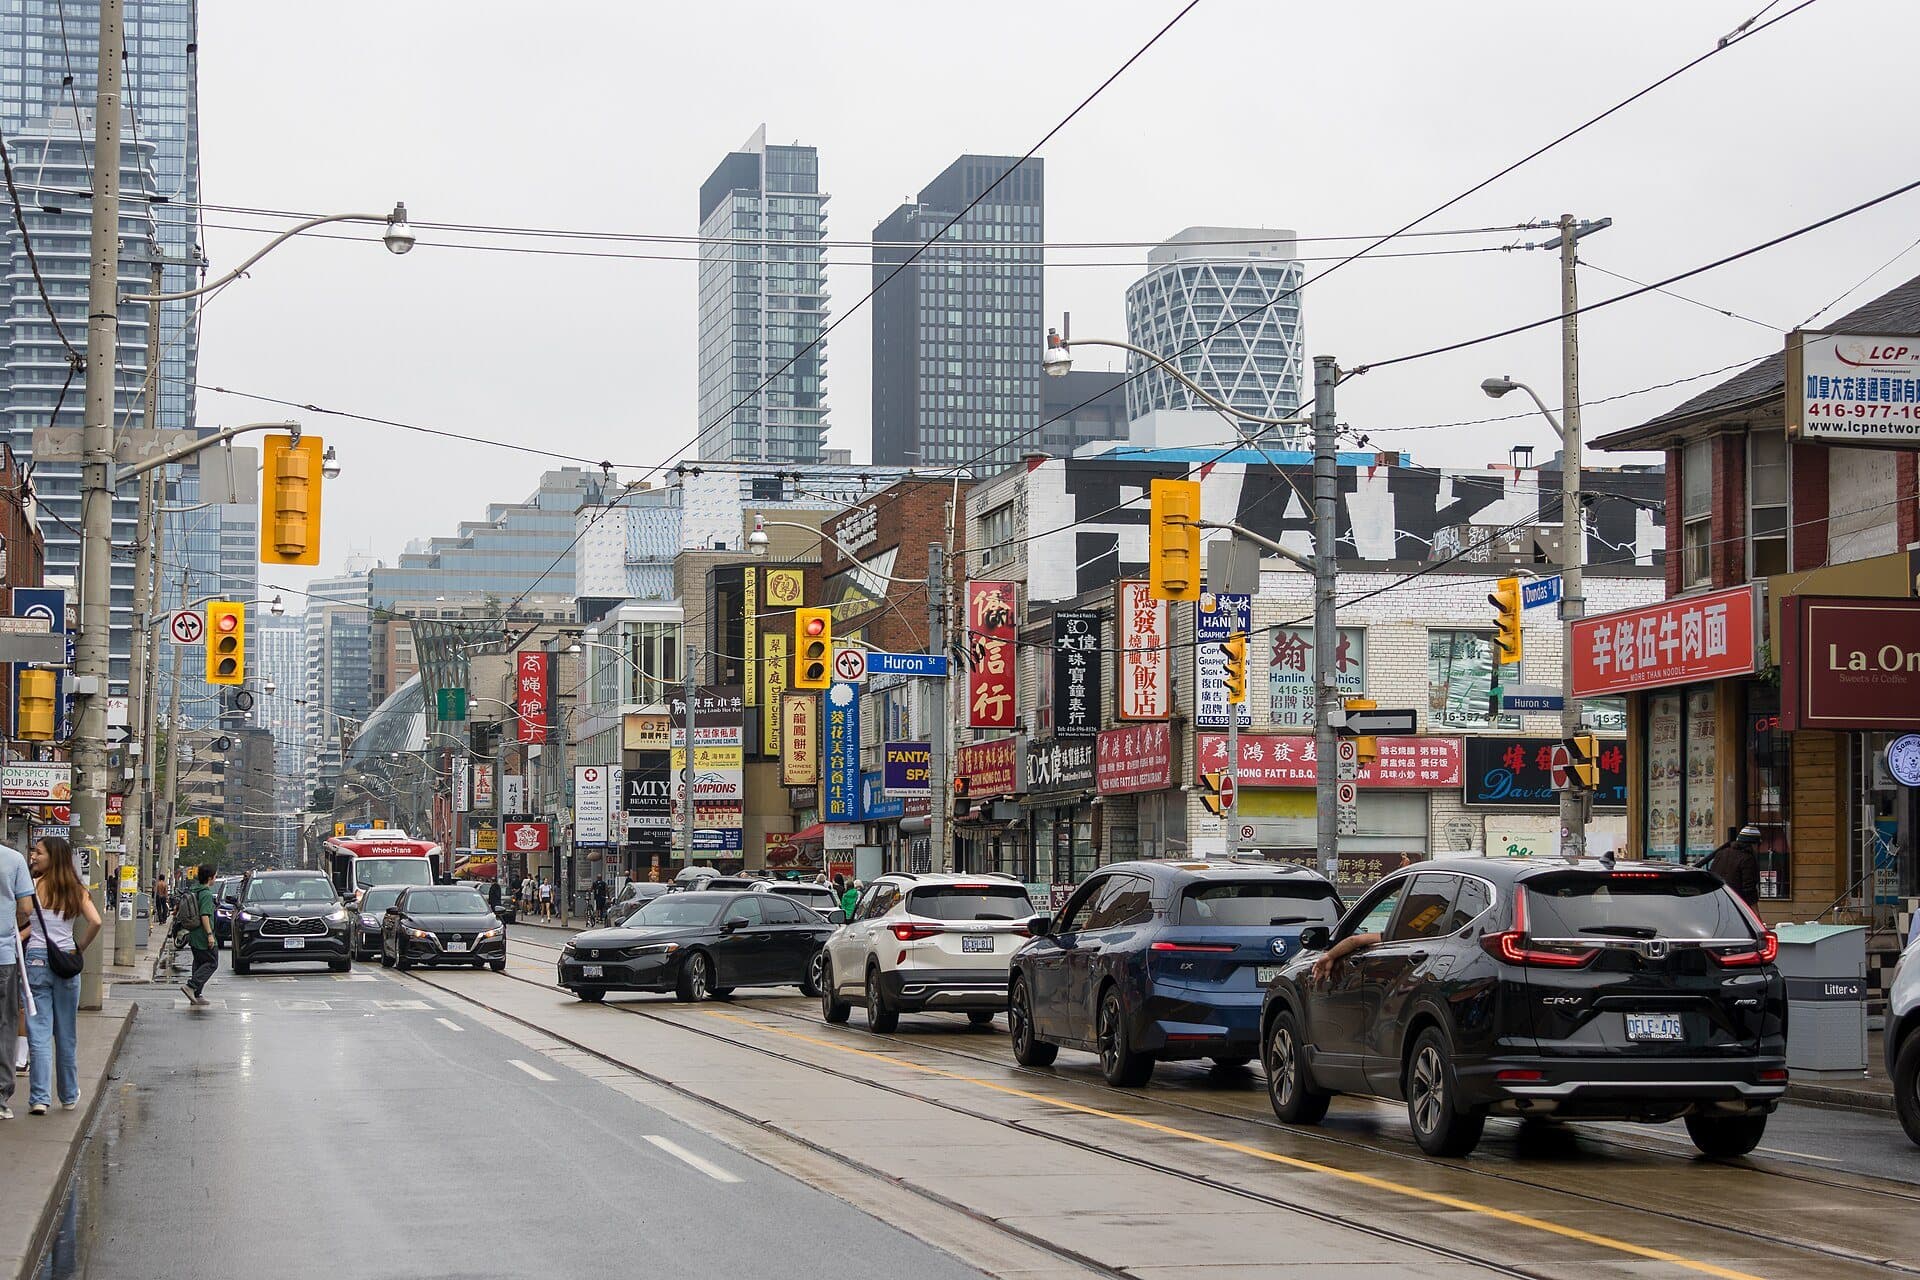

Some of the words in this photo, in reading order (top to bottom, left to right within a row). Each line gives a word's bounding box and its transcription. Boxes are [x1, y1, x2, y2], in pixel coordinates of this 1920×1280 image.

[1869, 346, 1908, 360] LCP
[1526, 584, 1548, 603] Dundas
[1203, 617, 1246, 628] HANN
[1201, 646, 1219, 655] COPY
[884, 656, 924, 670] Huron
[1201, 667, 1218, 676] SIGN
[1631, 672, 1645, 682] MORE
[1647, 669, 1661, 679] THAN
[1663, 666, 1686, 677] NOODLE
[1270, 673, 1305, 682] Hanlin
[1839, 674, 1870, 683] Sweets
[1880, 674, 1908, 683] Coffee
[1133, 665, 1157, 715] 飯店
[1514, 698, 1540, 708] Huron
[1542, 700, 1550, 708] St
[1238, 769, 1261, 778] HONG
[1264, 769, 1287, 778] FATT
[1290, 769, 1316, 779] B.B.Q.
[27, 779, 49, 787] BASE
[631, 780, 670, 796] MIY
[1478, 768, 1552, 799] David
[677, 784, 737, 793] CAMPIONS
[372, 846, 411, 854] Wheel-Trans
[1825, 984, 1847, 995] Litter
[1543, 997, 1581, 1005] CR-V
